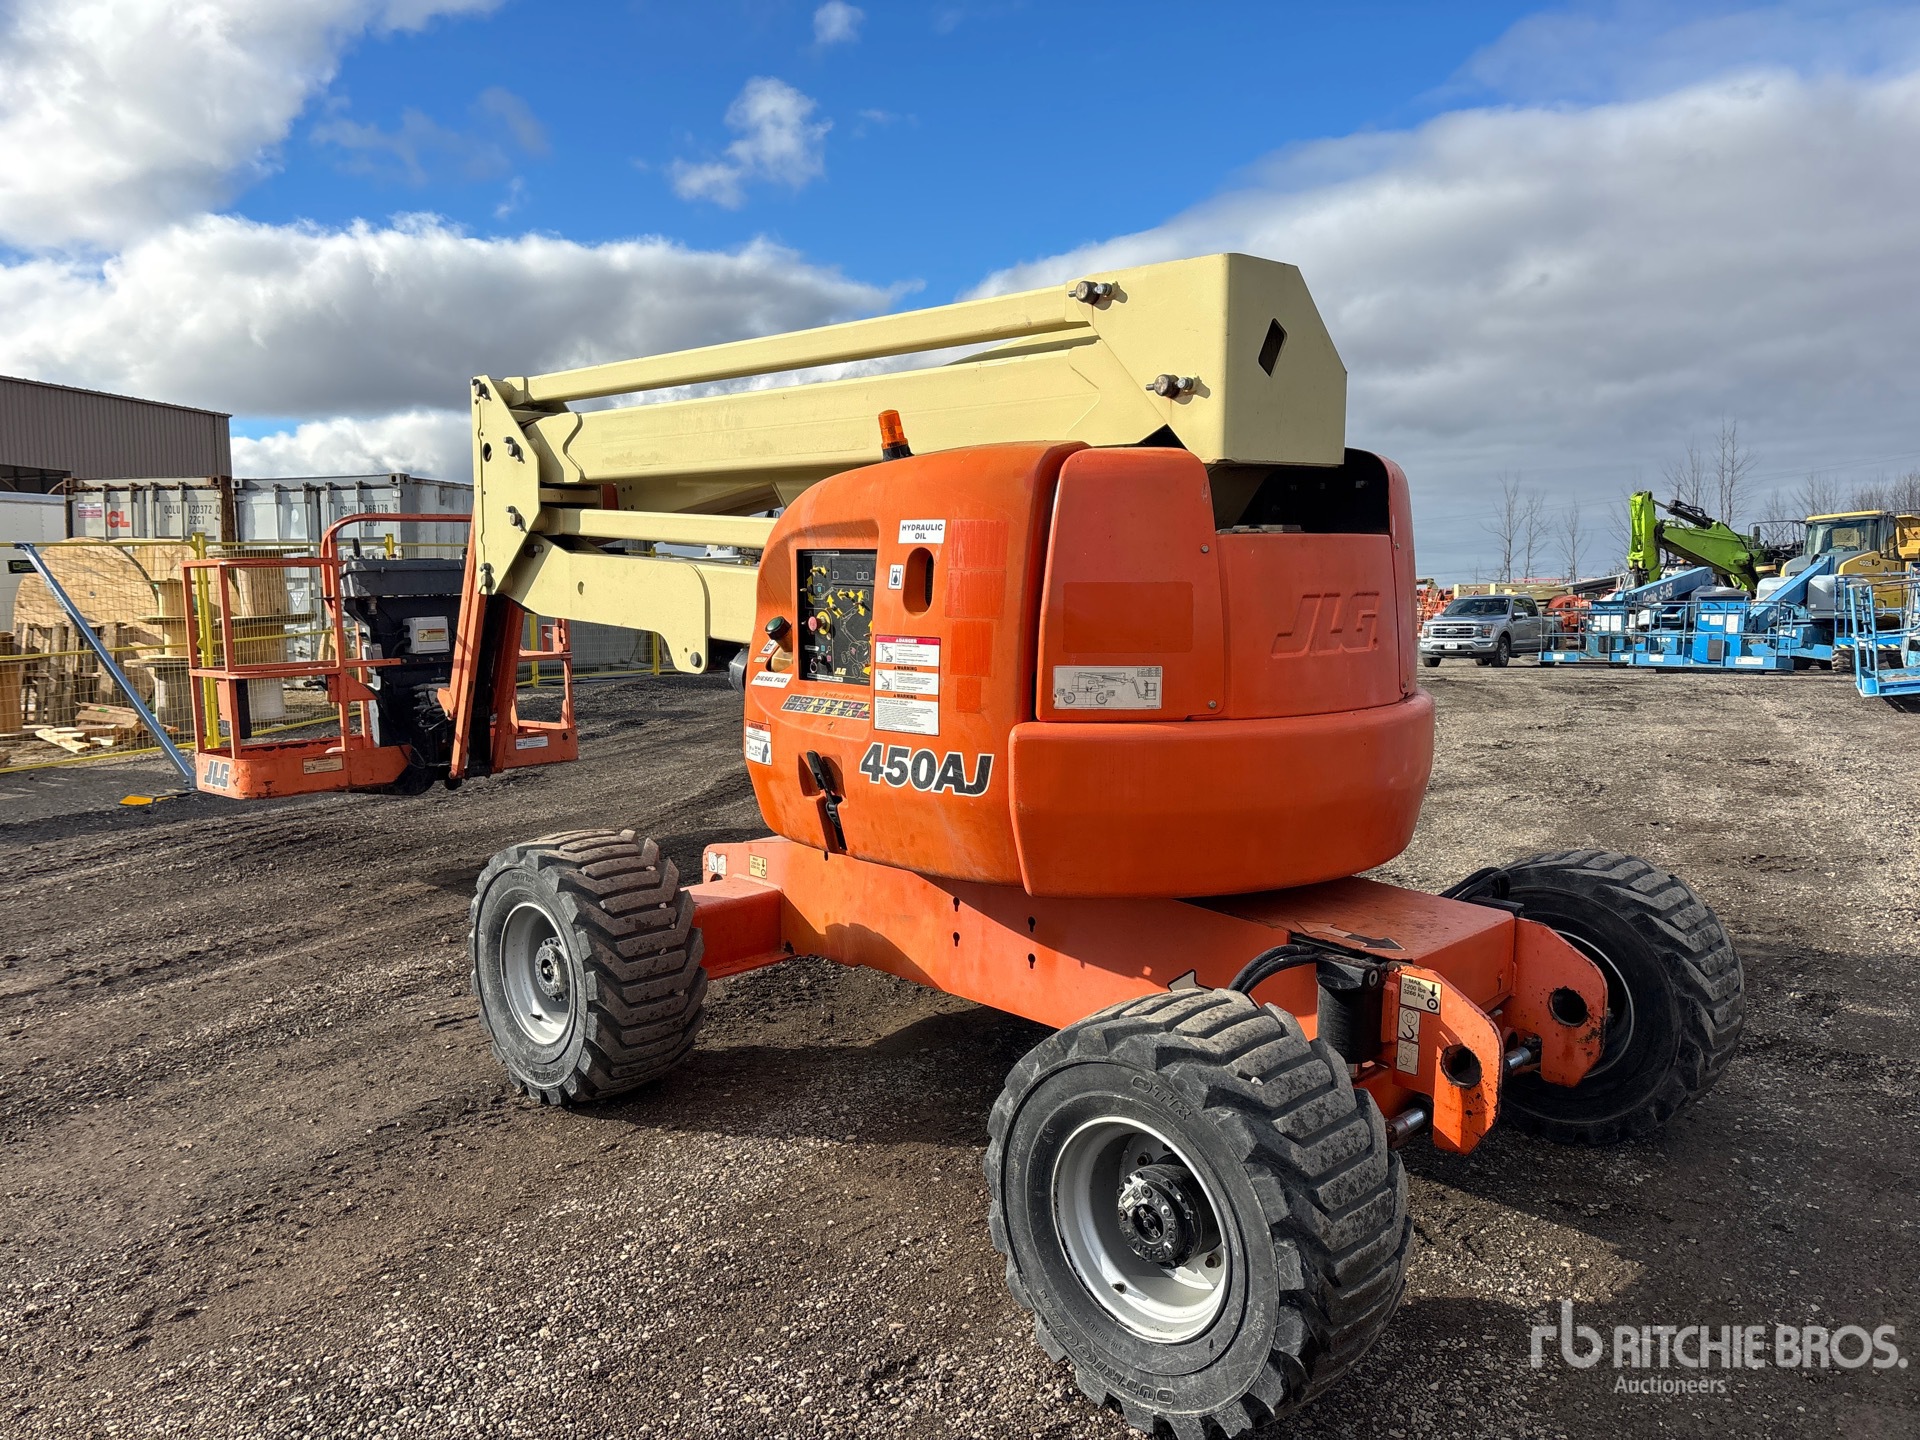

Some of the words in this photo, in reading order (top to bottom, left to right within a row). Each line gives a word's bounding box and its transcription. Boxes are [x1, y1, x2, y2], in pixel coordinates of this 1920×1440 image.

[901, 523, 944, 532] HYDRAULIC
[914, 532, 927, 540] OIL
[1271, 592, 1379, 659] JLG
[834, 667, 847, 676] JLG
[204, 759, 231, 789] JLG
[859, 741, 995, 797] 450AJ
[1131, 1076, 1192, 1121] OTR
